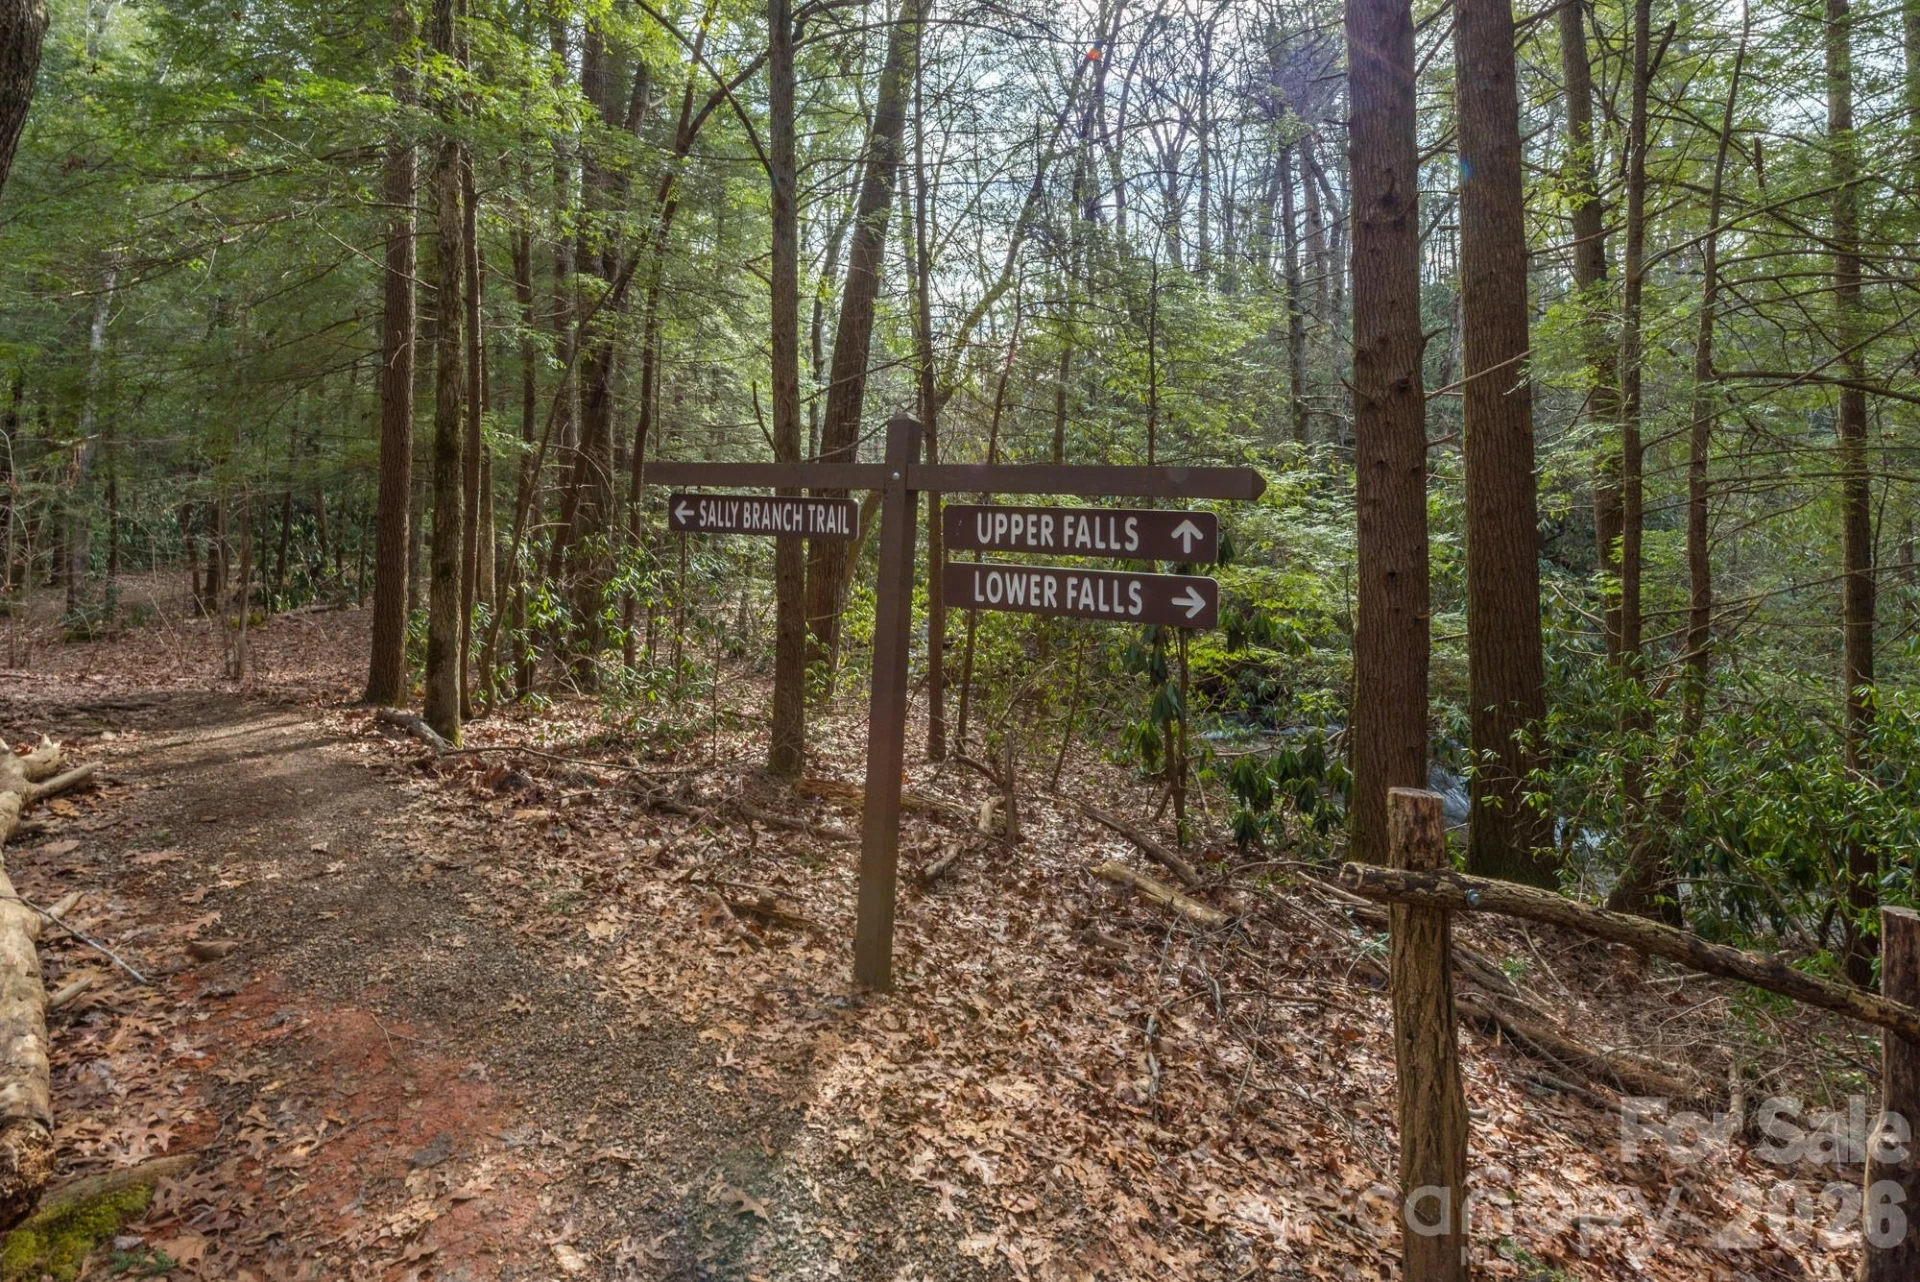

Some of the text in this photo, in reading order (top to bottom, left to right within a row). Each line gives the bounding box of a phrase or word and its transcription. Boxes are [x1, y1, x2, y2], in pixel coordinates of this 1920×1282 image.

[700, 500, 850, 535] SALLY BRANCH TRAIL
[977, 512, 1139, 551] UPPER FALLS
[974, 570, 1143, 616] LOWER FALLS
